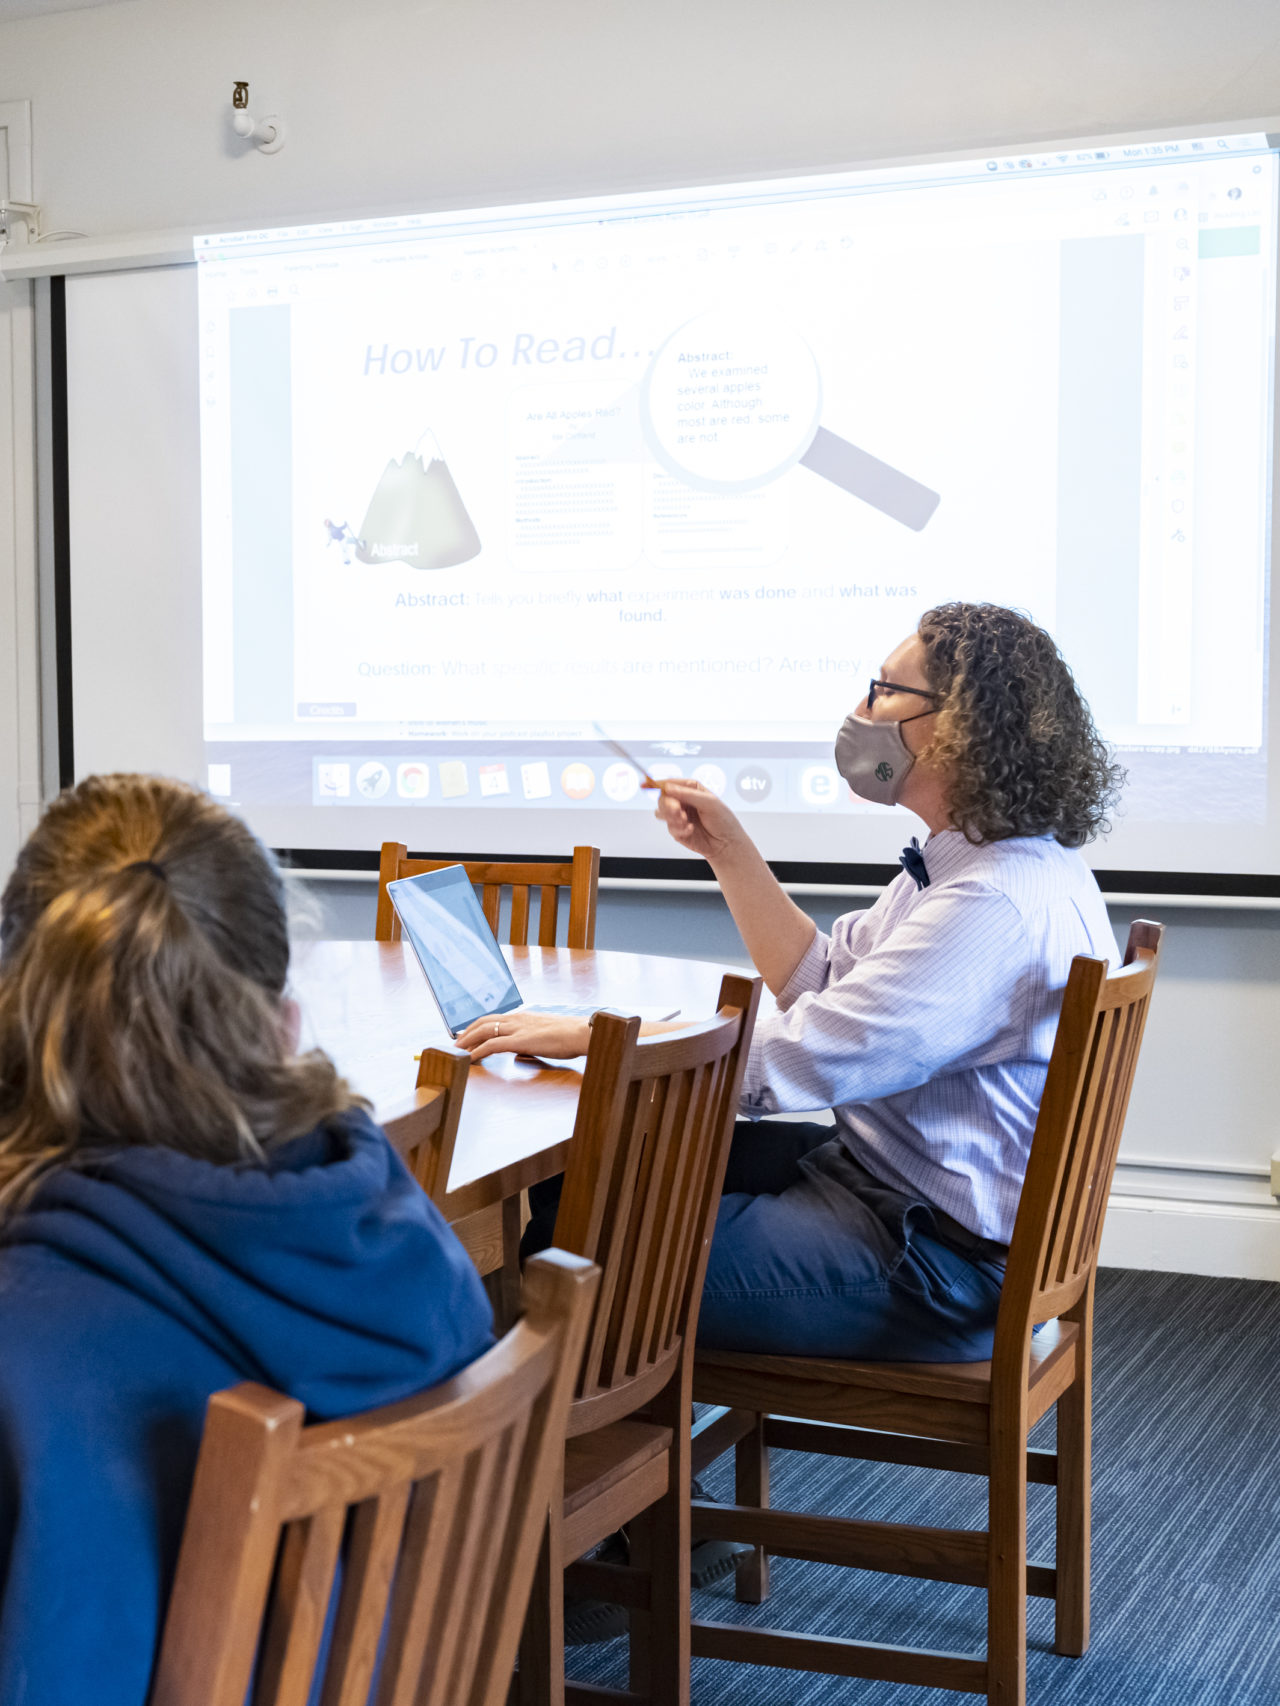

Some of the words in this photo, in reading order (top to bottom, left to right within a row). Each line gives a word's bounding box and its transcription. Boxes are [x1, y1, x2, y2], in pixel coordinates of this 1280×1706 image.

[1164, 143, 1179, 153] PM
[362, 342, 446, 376] How
[458, 336, 499, 369] To
[511, 325, 656, 367] Read...
[677, 350, 734, 365] Abstract:
[687, 366, 708, 381] We
[710, 363, 769, 378] examined
[676, 381, 720, 396] several
[723, 378, 761, 397] apples
[711, 396, 763, 411] Although
[525, 411, 544, 422] Are
[545, 409, 558, 420] All
[559, 408, 593, 421] Apples
[676, 416, 706, 428] most
[708, 415, 728, 427] are
[757, 411, 791, 424] some
[676, 434, 696, 446] are
[370, 542, 419, 558] Abstract
[394, 591, 470, 608] Abstract:
[475, 591, 503, 607] Tells
[507, 592, 534, 609] you
[538, 588, 582, 607] briefly
[586, 589, 623, 604] what
[626, 587, 714, 604] experiment
[720, 587, 750, 600] was
[754, 585, 797, 600] done
[801, 584, 834, 600] and
[838, 583, 880, 598] what
[884, 584, 918, 598] was
[618, 608, 668, 623] found.
[357, 660, 436, 678] Question:
[441, 659, 487, 677] What
[492, 658, 561, 679] specific
[564, 657, 619, 676] results
[622, 659, 654, 674] are
[658, 654, 775, 674] mentioned?
[779, 655, 813, 674] Are
[817, 655, 862, 677] they
